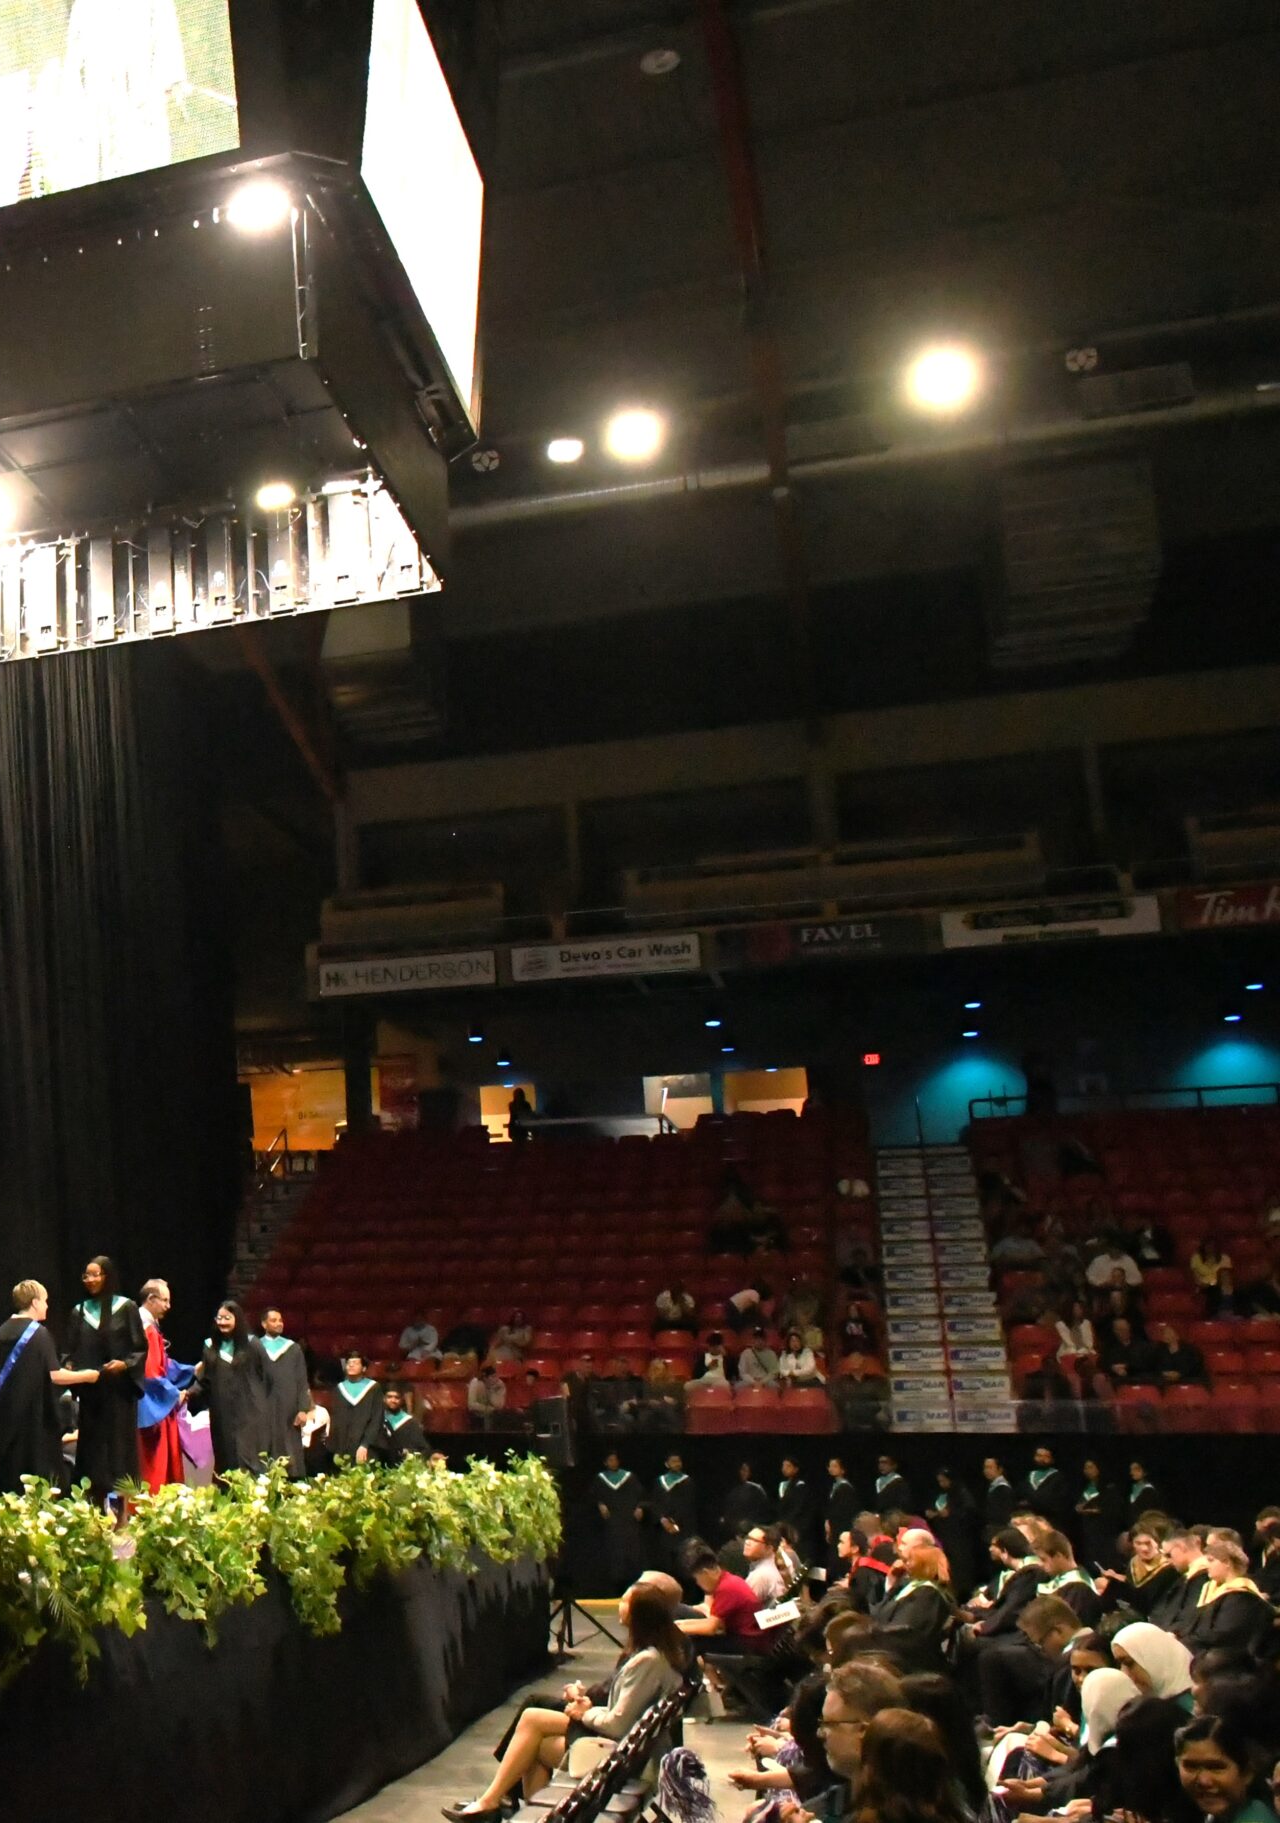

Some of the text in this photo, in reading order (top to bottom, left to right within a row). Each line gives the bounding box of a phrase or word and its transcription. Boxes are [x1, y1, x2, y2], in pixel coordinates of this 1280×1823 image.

[559, 948, 613, 963] Devo's
[617, 946, 643, 959] Car
[648, 942, 692, 957] Wash
[354, 958, 491, 985] HENDERSON
